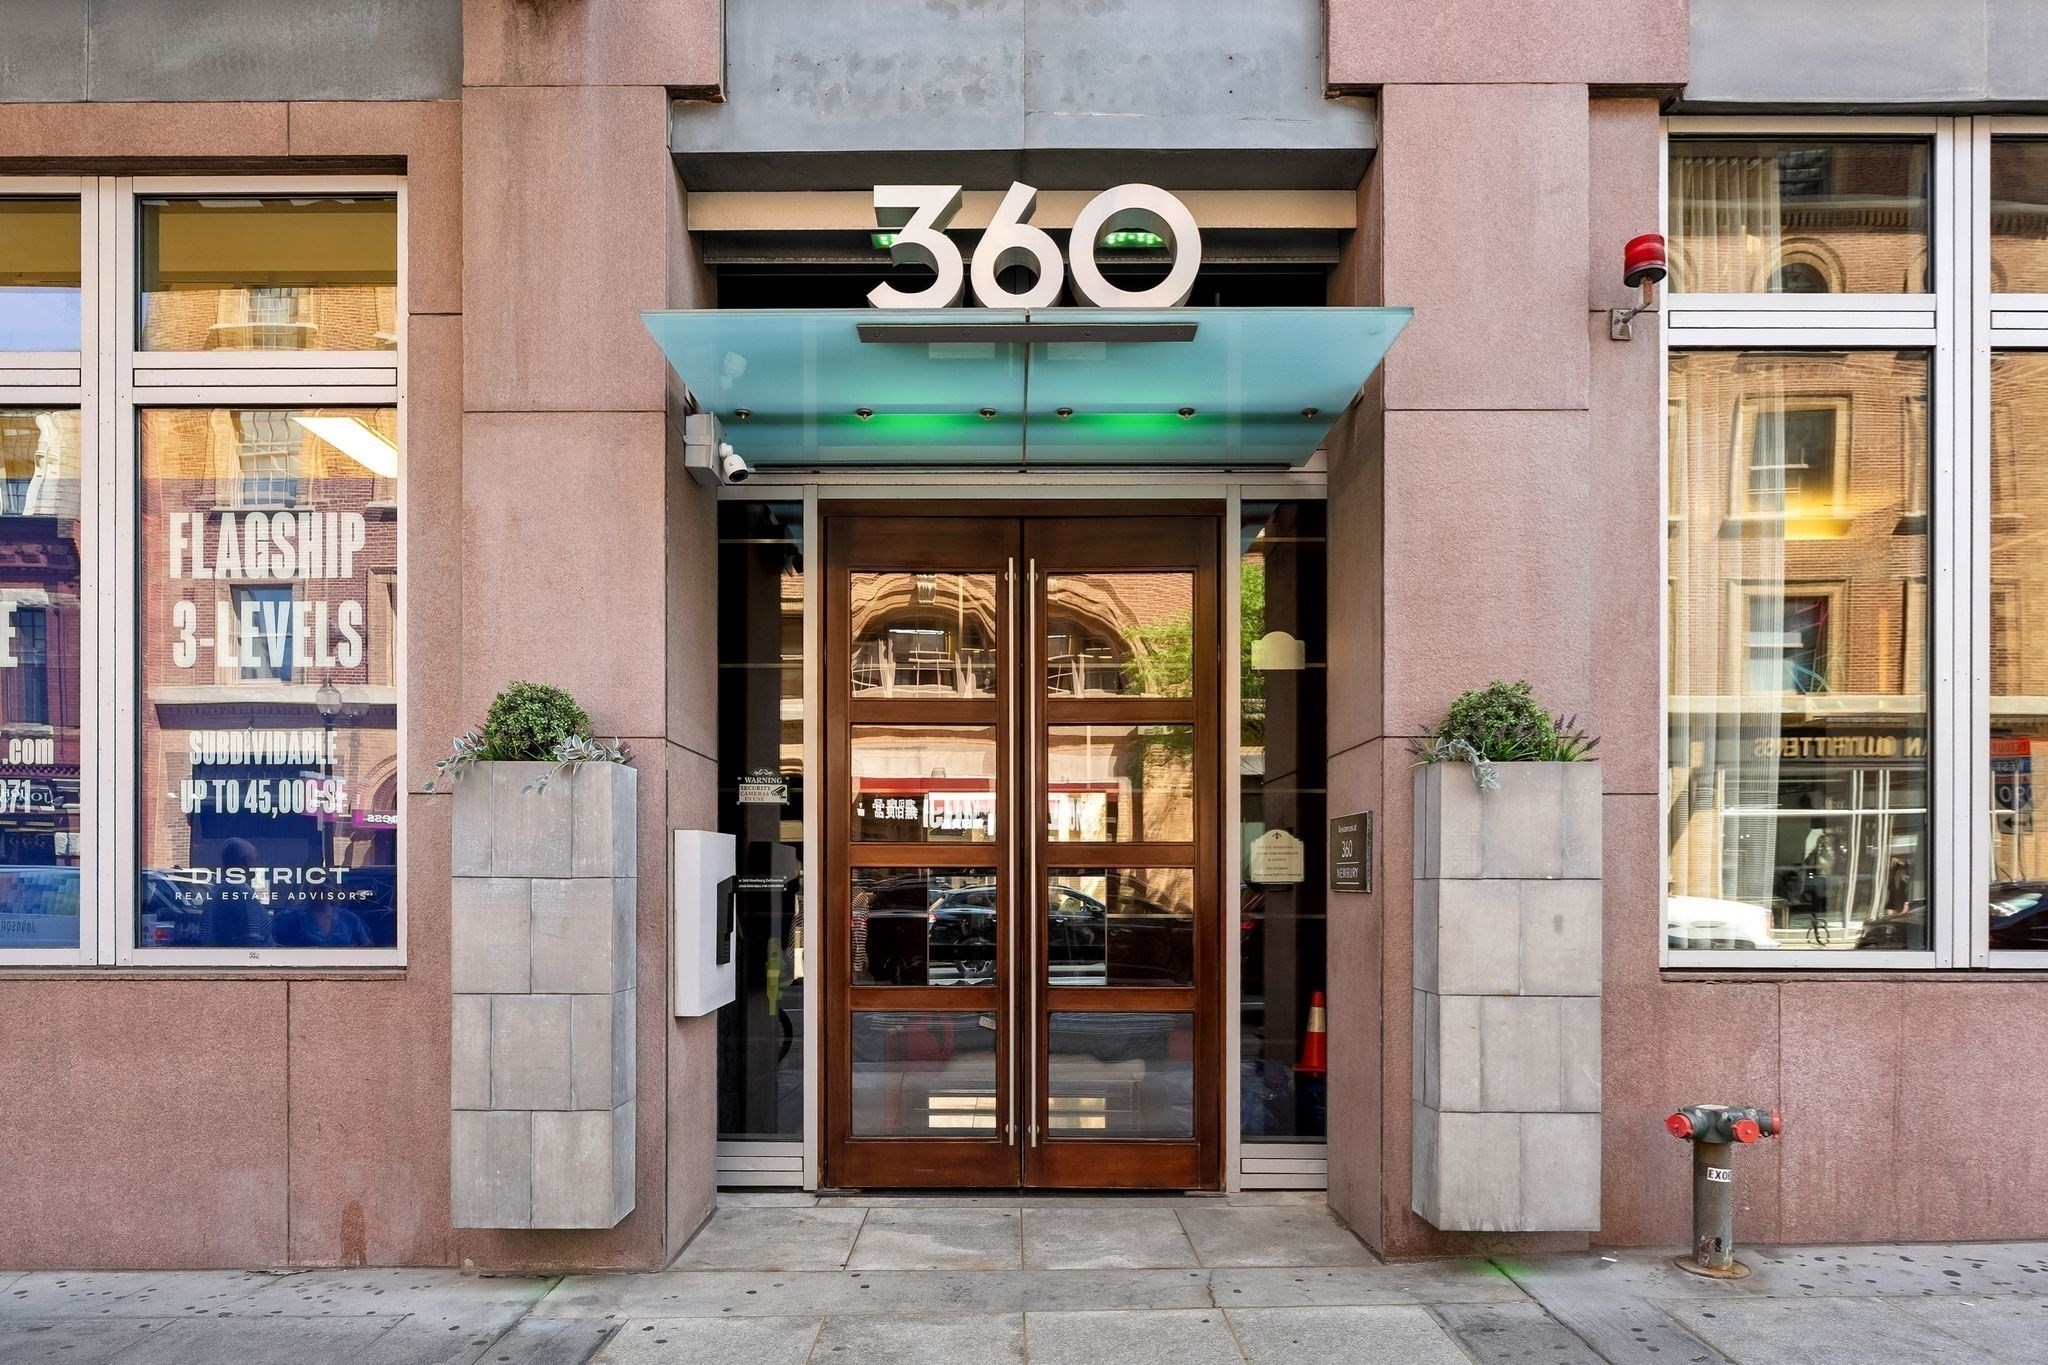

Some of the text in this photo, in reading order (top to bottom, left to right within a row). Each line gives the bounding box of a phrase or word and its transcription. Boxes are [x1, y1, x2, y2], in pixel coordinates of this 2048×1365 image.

[866, 180, 1203, 309] 360
[169, 511, 366, 579] FLAGSHIP
[172, 600, 364, 669] 3-LEVELS
[189, 730, 338, 765] SUBDIVIDABLE
[180, 779, 207, 814] UP
[212, 779, 239, 814] TO
[244, 779, 318, 818] 45,000
[323, 779, 347, 814] SF
[1341, 840, 1353, 858] 360
[191, 867, 350, 885] DISTRICT
[1337, 867, 1358, 878] NEWBURY
[175, 892, 367, 900] REAL ESTATE ADVISORS
